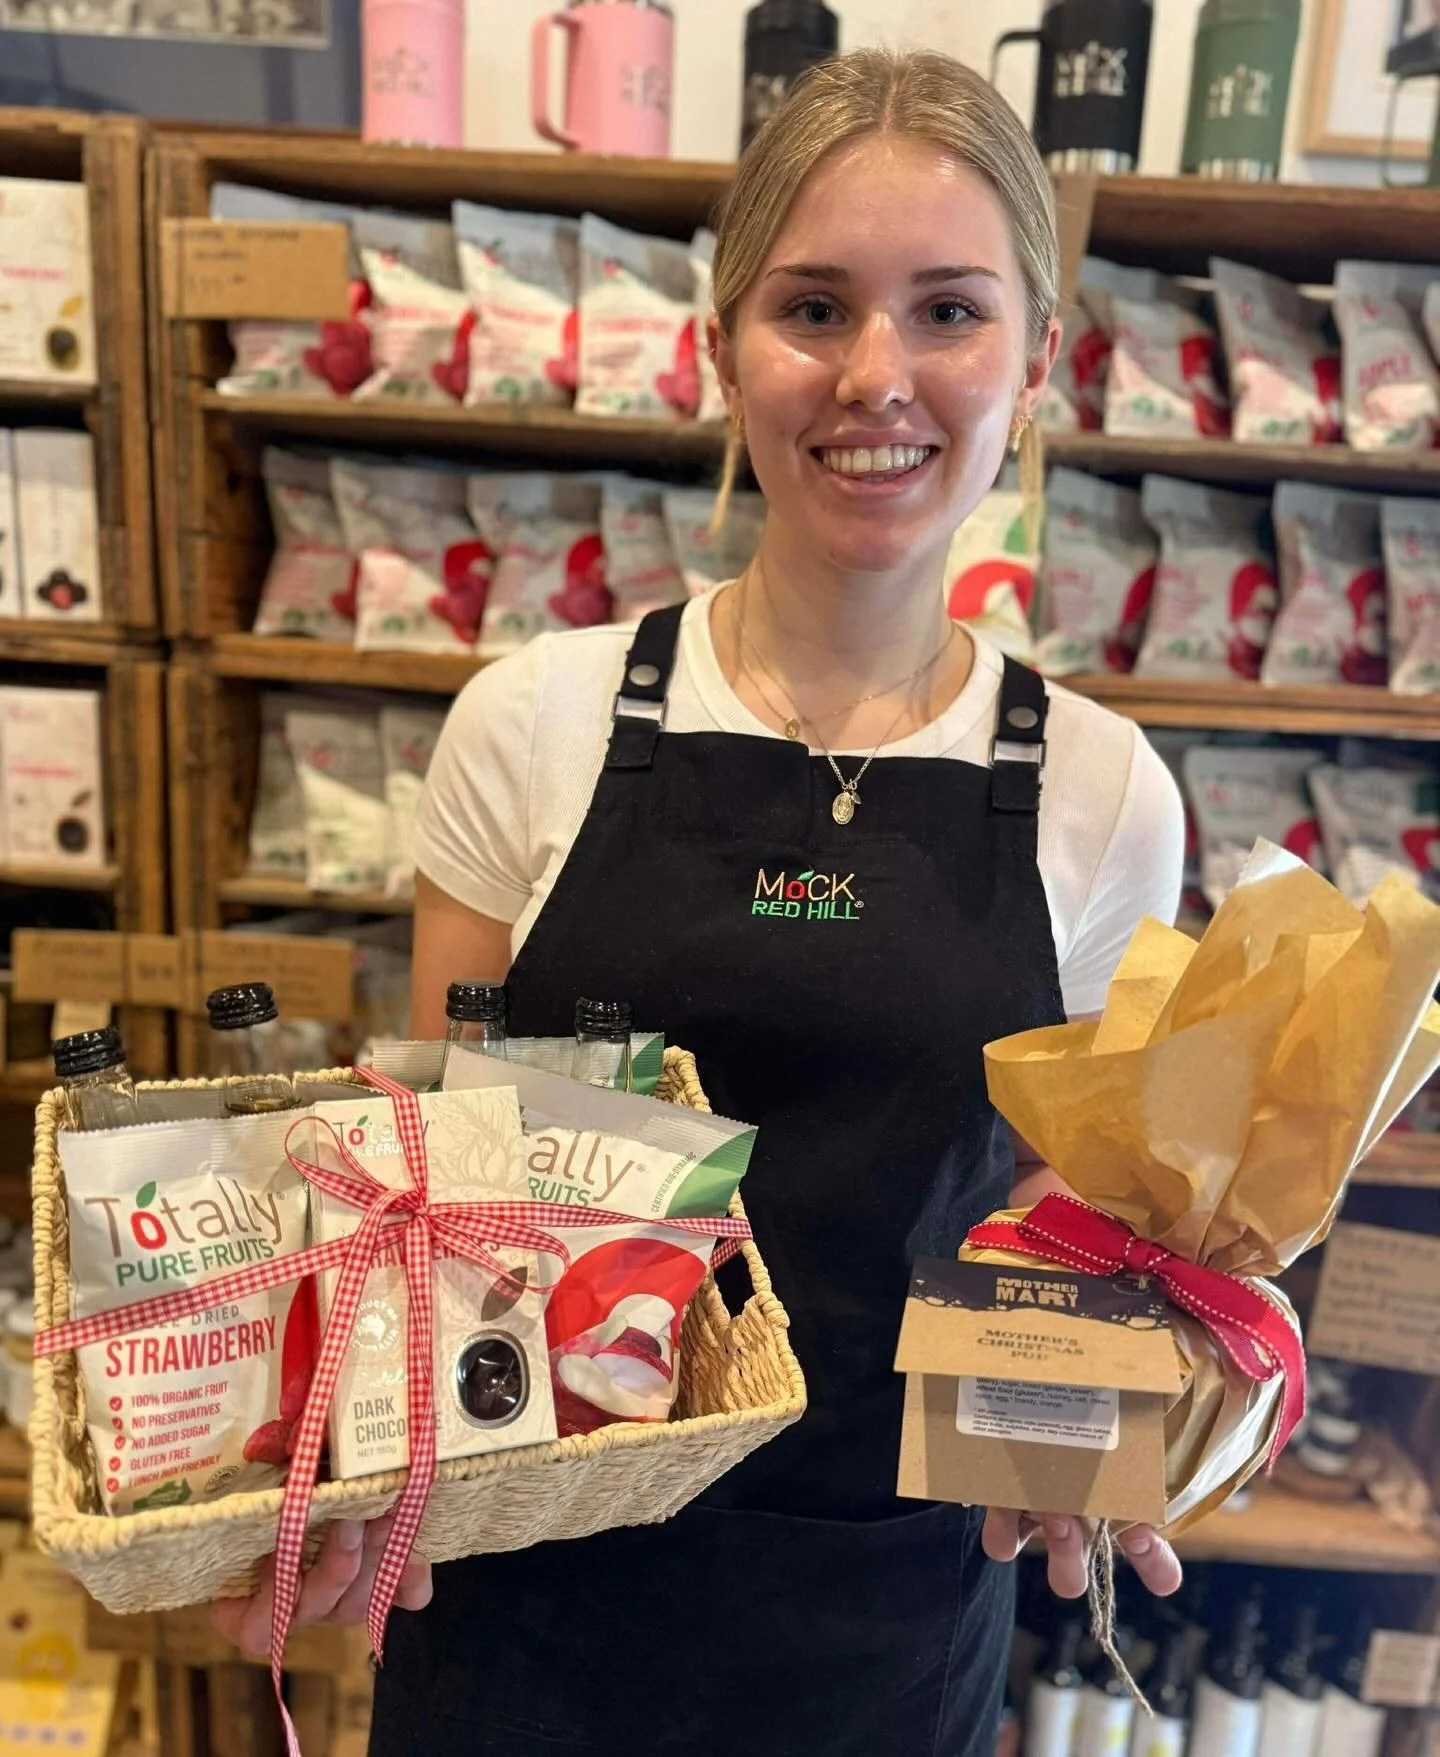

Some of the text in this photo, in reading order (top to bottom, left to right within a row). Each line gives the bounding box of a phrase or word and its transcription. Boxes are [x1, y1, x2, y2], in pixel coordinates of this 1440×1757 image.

[751, 900, 801, 918] RED
[527, 1131, 635, 1202] ally
[528, 1177, 591, 1206] RUITS
[85, 1180, 283, 1258] Totally
[116, 1238, 275, 1287] PURE FRUITS
[996, 1277, 1078, 1294] MOTHER
[996, 1286, 1079, 1308] MARY
[191, 1305, 240, 1326] DRIED
[105, 1315, 277, 1378] STRAWBERRY
[131, 1381, 229, 1408] 100% ORGANIC FRUIT
[354, 1396, 396, 1420] DARK
[132, 1403, 221, 1430] NO PRESERVATIVES
[132, 1423, 211, 1450] NO ADDED SUGAR
[130, 1446, 192, 1471] GLUTEN FREE
[357, 1447, 374, 1459] NET
